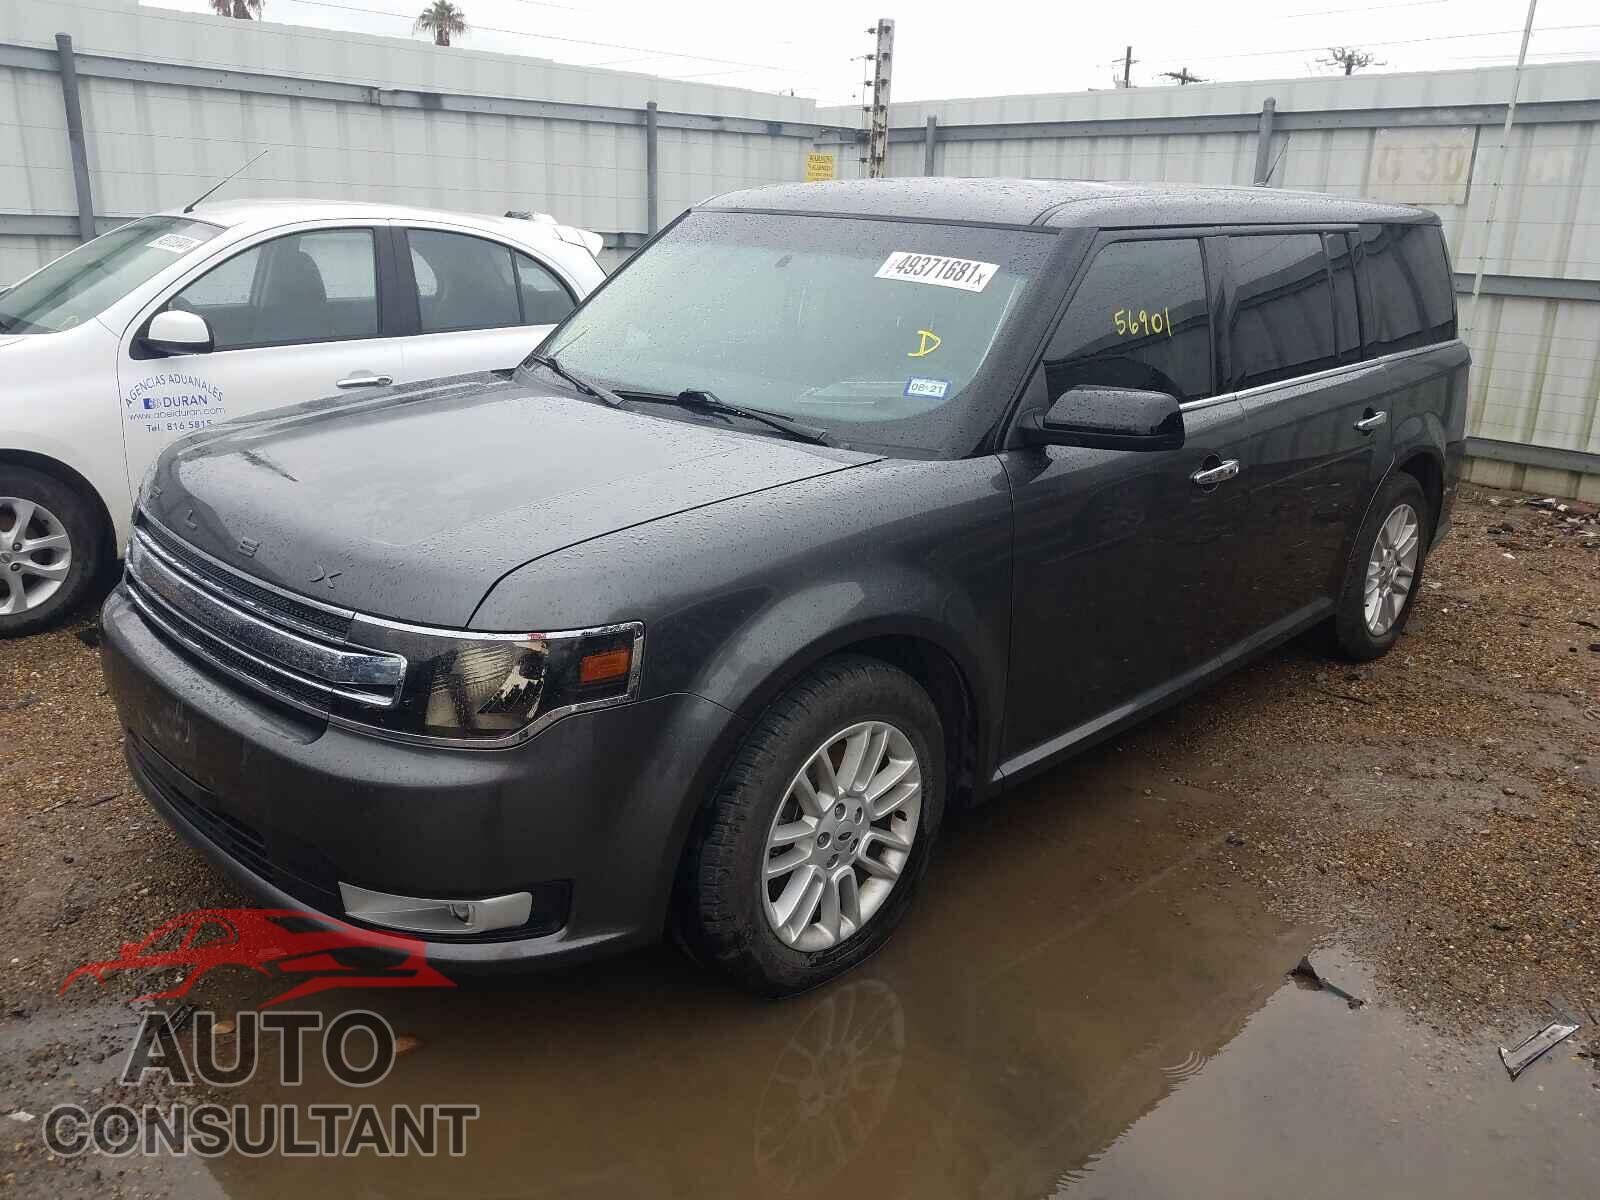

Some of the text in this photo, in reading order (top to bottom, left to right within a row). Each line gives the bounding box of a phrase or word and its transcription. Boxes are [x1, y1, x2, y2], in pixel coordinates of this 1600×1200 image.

[1114, 306, 1172, 337] 56901
[906, 330, 942, 357] D
[125, 373, 223, 408] AGENCIAS ADUANALES
[162, 394, 208, 408] DURAN
